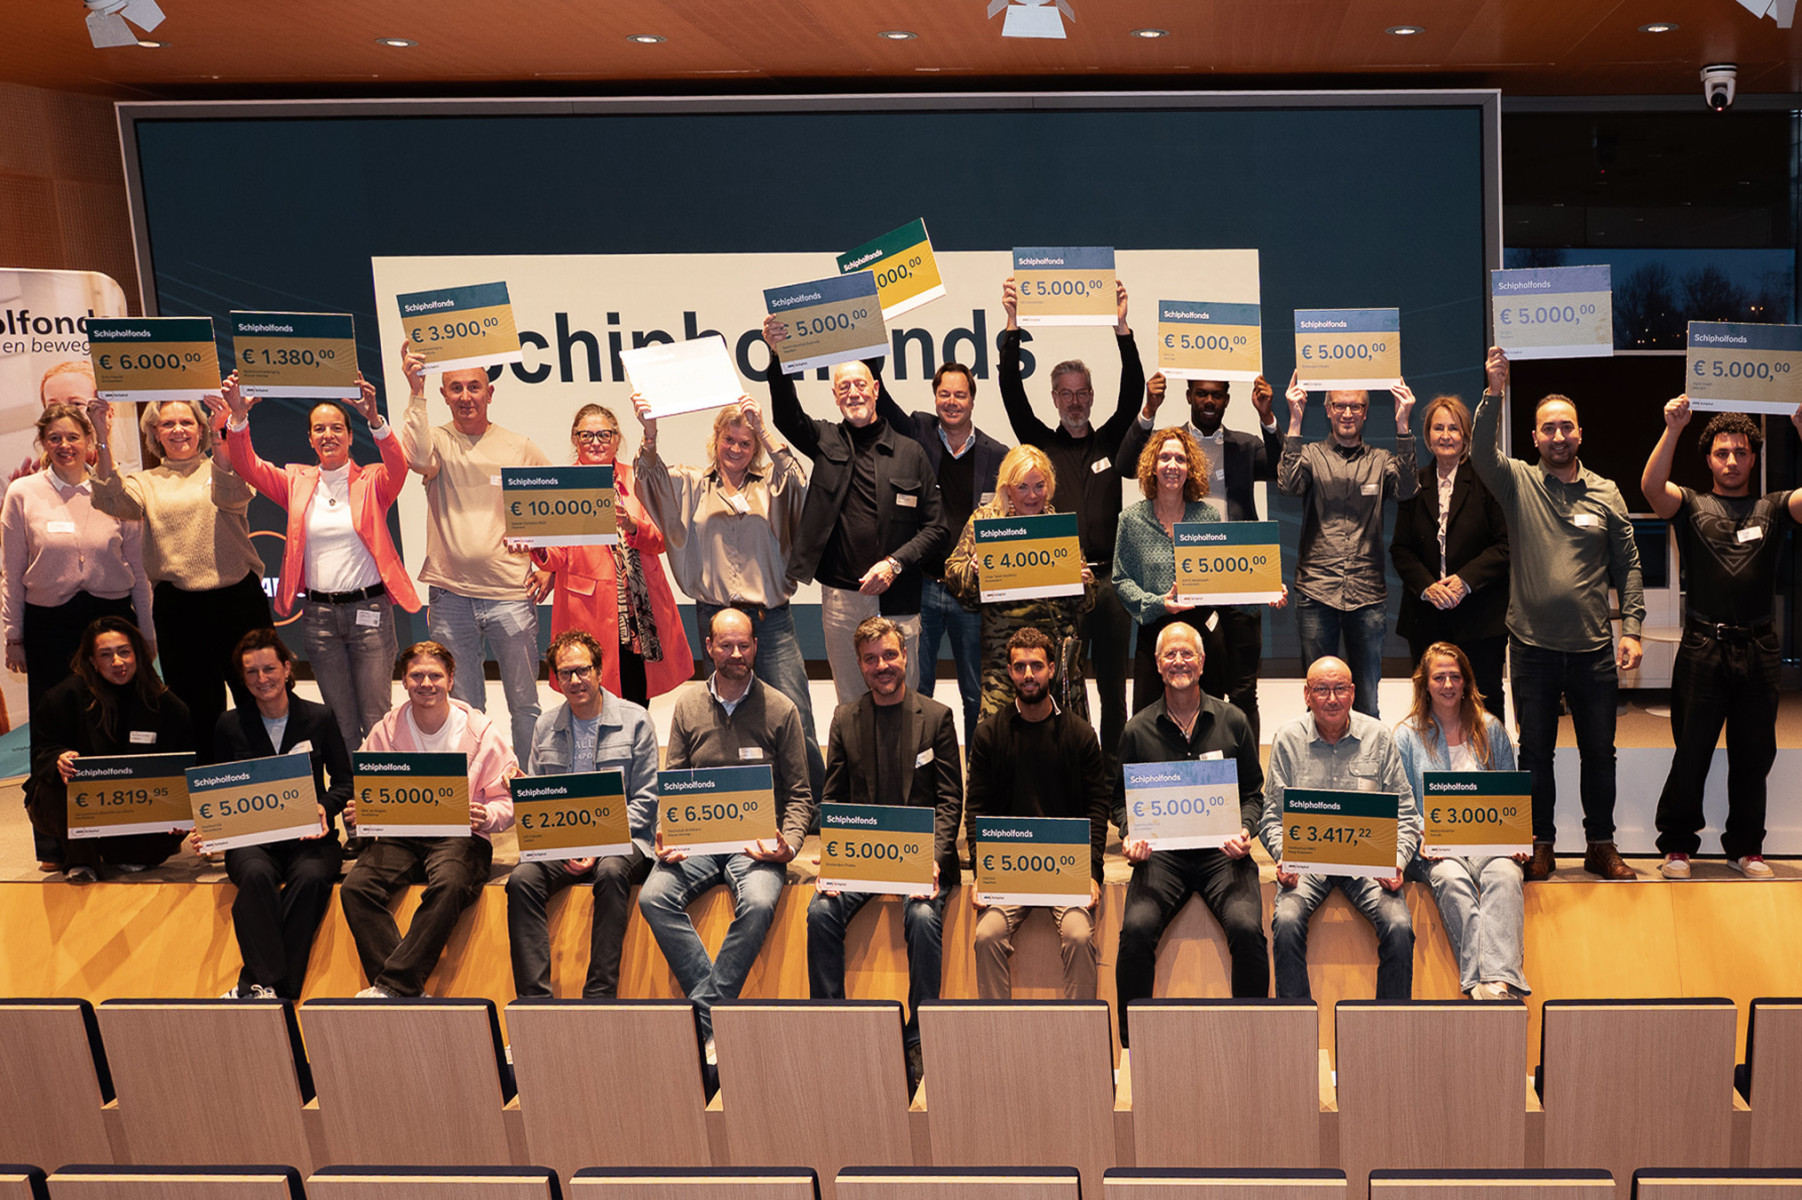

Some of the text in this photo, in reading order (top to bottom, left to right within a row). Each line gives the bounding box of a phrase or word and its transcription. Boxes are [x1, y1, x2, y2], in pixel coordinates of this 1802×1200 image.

[1018, 258, 1064, 266] Schipholfonds
[877, 256, 922, 290] .000,00
[1020, 280, 1103, 297] € 5.000,00
[1498, 281, 1551, 291] Schipholfonds
[404, 299, 455, 312] Schipholfonds
[771, 291, 821, 308] Schipholfonds
[796, 308, 867, 337] 5.000,00
[1164, 311, 1209, 319] Schipholfonds
[1500, 304, 1596, 325] € 5.000,00
[238, 323, 293, 332] Schipholfonds
[411, 317, 498, 343] € 3.900,00
[1300, 320, 1347, 328] Schipholfonds
[93, 329, 151, 338] Schipholfonds
[1694, 334, 1748, 343] Schipholfonds
[3, 341, 25, 353] en
[1164, 334, 1247, 353] € 5.000,00
[1302, 343, 1386, 361] € 5.000,00
[99, 352, 201, 371] € 6.000,00
[242, 348, 335, 368] € 1.380,00
[1694, 360, 1791, 382] € 5.000,00
[508, 478, 558, 486] Schipholfonds
[510, 499, 611, 517] € 10.000,00
[980, 528, 1027, 538] Schipholfonds
[1180, 533, 1227, 542] Schipholfonds
[983, 548, 1068, 570] € 4.000,00
[1182, 556, 1266, 574] € 5.000,00
[76, 767, 133, 777] Schipholfonds
[359, 763, 410, 772] Schipholfonds
[194, 772, 250, 787] Schipholfonds
[664, 781, 716, 790] Schipholfonds
[1130, 773, 1181, 784] Schipholfonds
[1429, 782, 1478, 792] Schipholfonds
[76, 788, 169, 808] € 1.819,95
[361, 788, 454, 807] € 5.000,00
[517, 787, 568, 797] Schipholfonds
[199, 789, 299, 819] € 5.000,00
[666, 801, 758, 822] € 6.500,00
[1133, 796, 1224, 817] € 5.000,00
[1289, 800, 1341, 810] Schipholfonds
[521, 808, 610, 829] € 2.200,00
[826, 815, 878, 825] Schipholfonds
[1430, 807, 1516, 826] € 3.000,00
[982, 828, 1033, 838] Schipholfonds
[1289, 825, 1372, 847] € 3.417,22
[826, 841, 919, 863] € 5.000,00
[983, 855, 1076, 875] € 5.000,00
